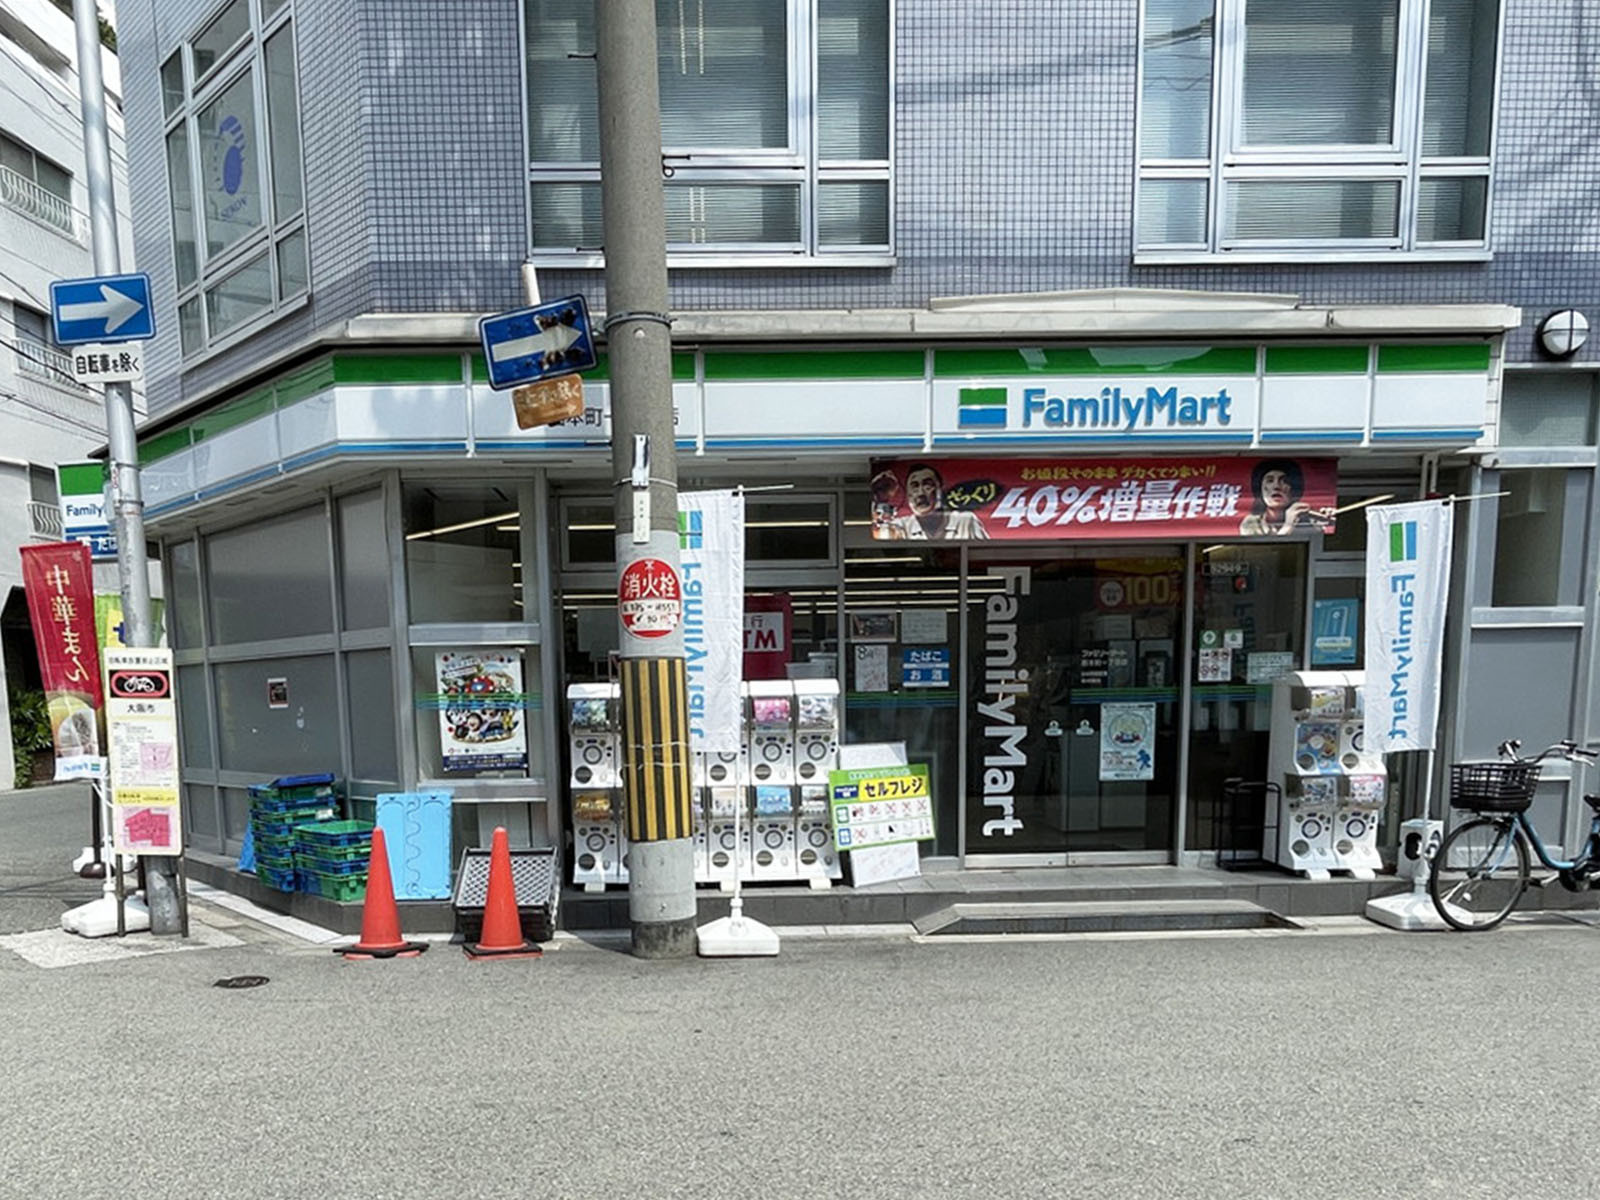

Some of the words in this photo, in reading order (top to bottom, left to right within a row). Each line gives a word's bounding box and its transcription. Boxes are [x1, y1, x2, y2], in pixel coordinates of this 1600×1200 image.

[75, 352, 141, 376] 自転車を除く
[1023, 387, 1233, 431] FamilyMart
[946, 483, 995, 508] ざっくり
[991, 479, 1242, 528] 40%増量作戦
[66, 503, 106, 518] Family
[624, 572, 676, 598] 消火栓
[743, 630, 777, 649] TM
[910, 650, 942, 663] たばこ
[976, 566, 1032, 836] FamilyMart
[865, 777, 923, 798] セルフレジ
